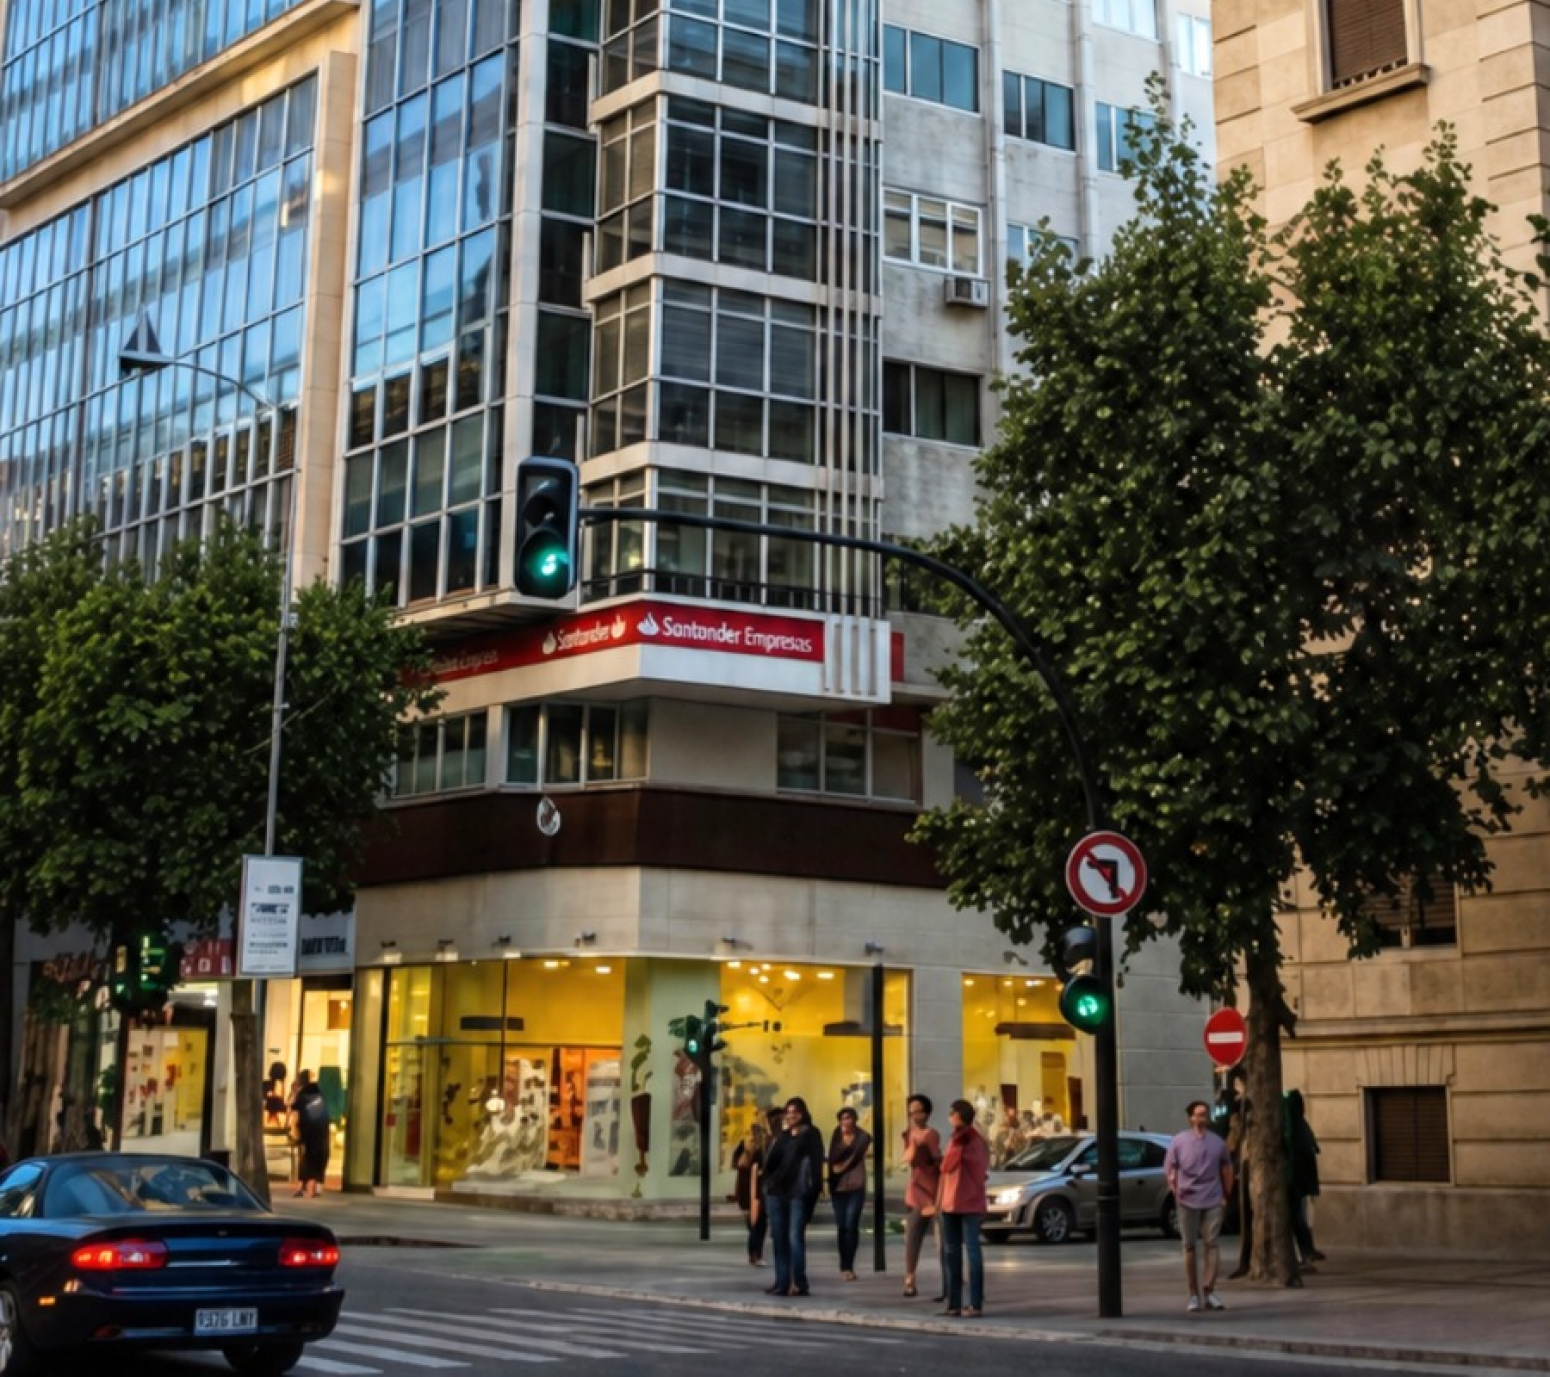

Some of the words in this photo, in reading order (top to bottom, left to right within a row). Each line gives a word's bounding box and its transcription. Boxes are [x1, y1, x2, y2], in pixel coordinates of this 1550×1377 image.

[557, 620, 610, 650] Santander
[663, 616, 742, 645] Santander
[744, 626, 812, 653] Empresas
